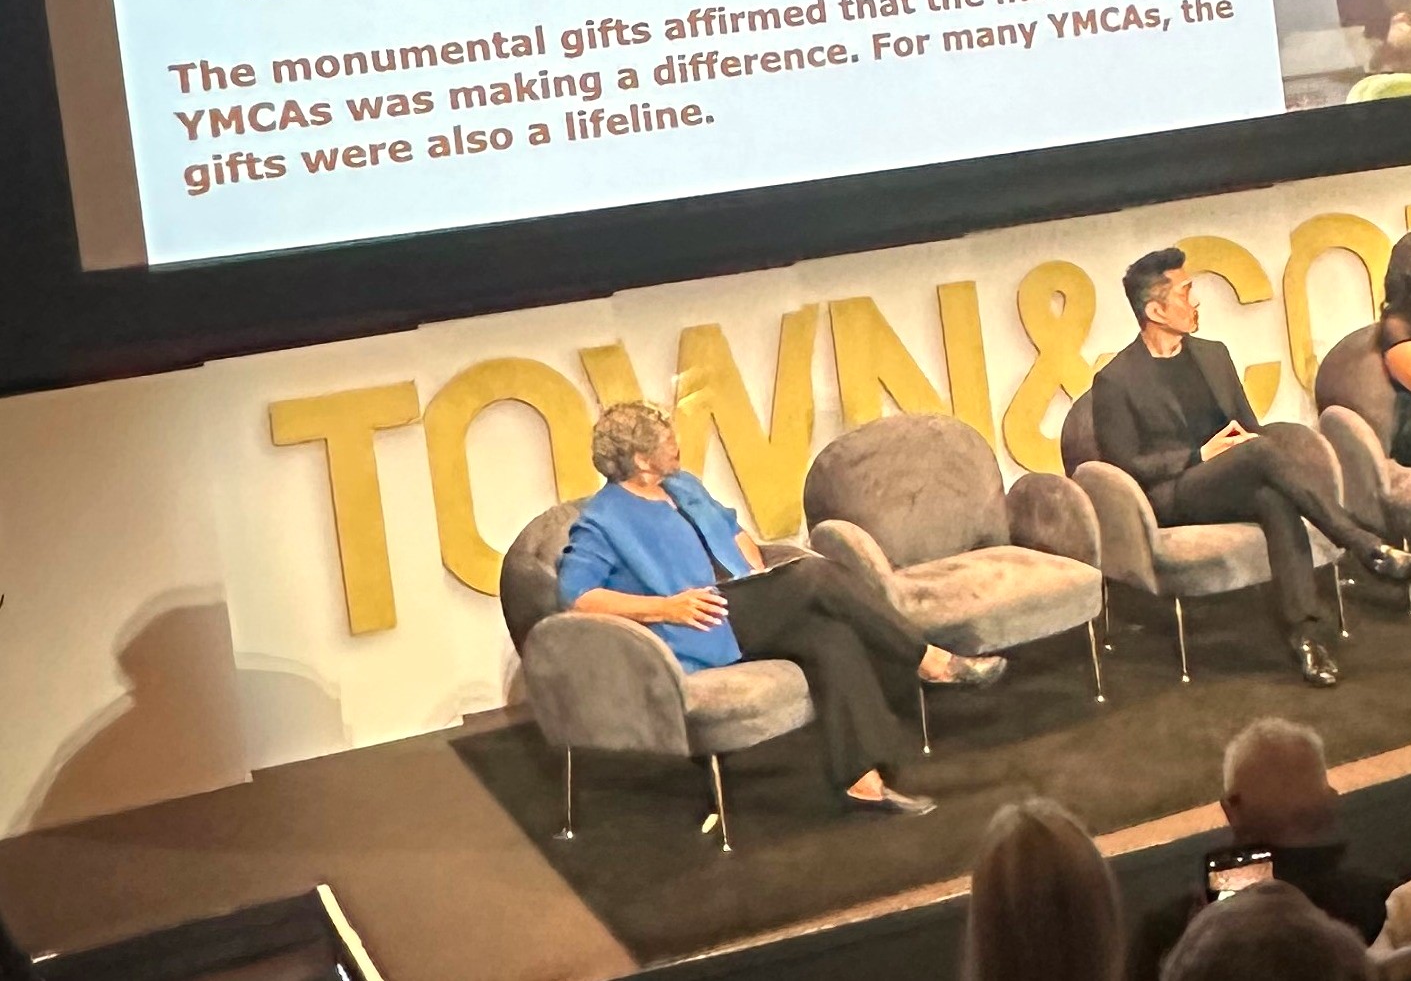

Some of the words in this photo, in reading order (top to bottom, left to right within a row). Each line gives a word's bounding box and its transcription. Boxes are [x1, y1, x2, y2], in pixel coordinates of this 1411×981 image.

[166, 59, 257, 94] The
[272, 24, 546, 84] monumental
[560, 17, 653, 60] gifts
[172, 99, 333, 141] YMCAs
[345, 90, 435, 122] was
[448, 69, 603, 111] making
[617, 67, 640, 91] a
[653, 43, 860, 87] difference.
[871, 32, 931, 61] For
[942, 20, 1038, 52] many
[1046, 3, 1171, 39] YMCAs,
[183, 151, 287, 197] gifts
[300, 139, 414, 174] were
[427, 124, 514, 159] also
[528, 122, 552, 146] a
[565, 102, 715, 142] lifeline.
